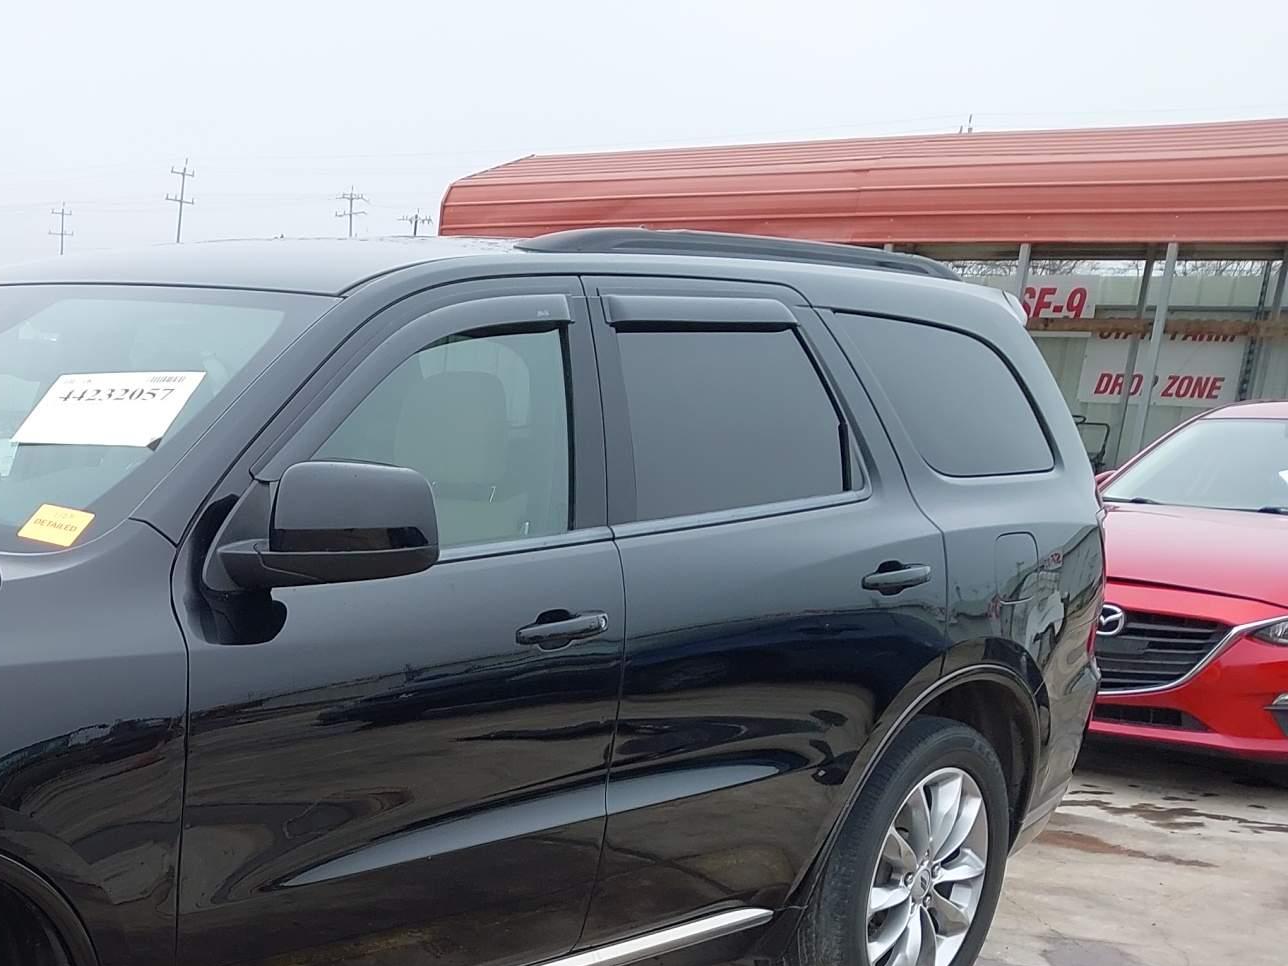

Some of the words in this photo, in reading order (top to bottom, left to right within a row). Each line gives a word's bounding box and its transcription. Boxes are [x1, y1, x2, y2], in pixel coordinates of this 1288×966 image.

[1023, 287, 1087, 320] SF-9
[58, 388, 175, 401] 44232057
[1161, 375, 1225, 399] ZONE
[33, 518, 78, 532] DETAILED
